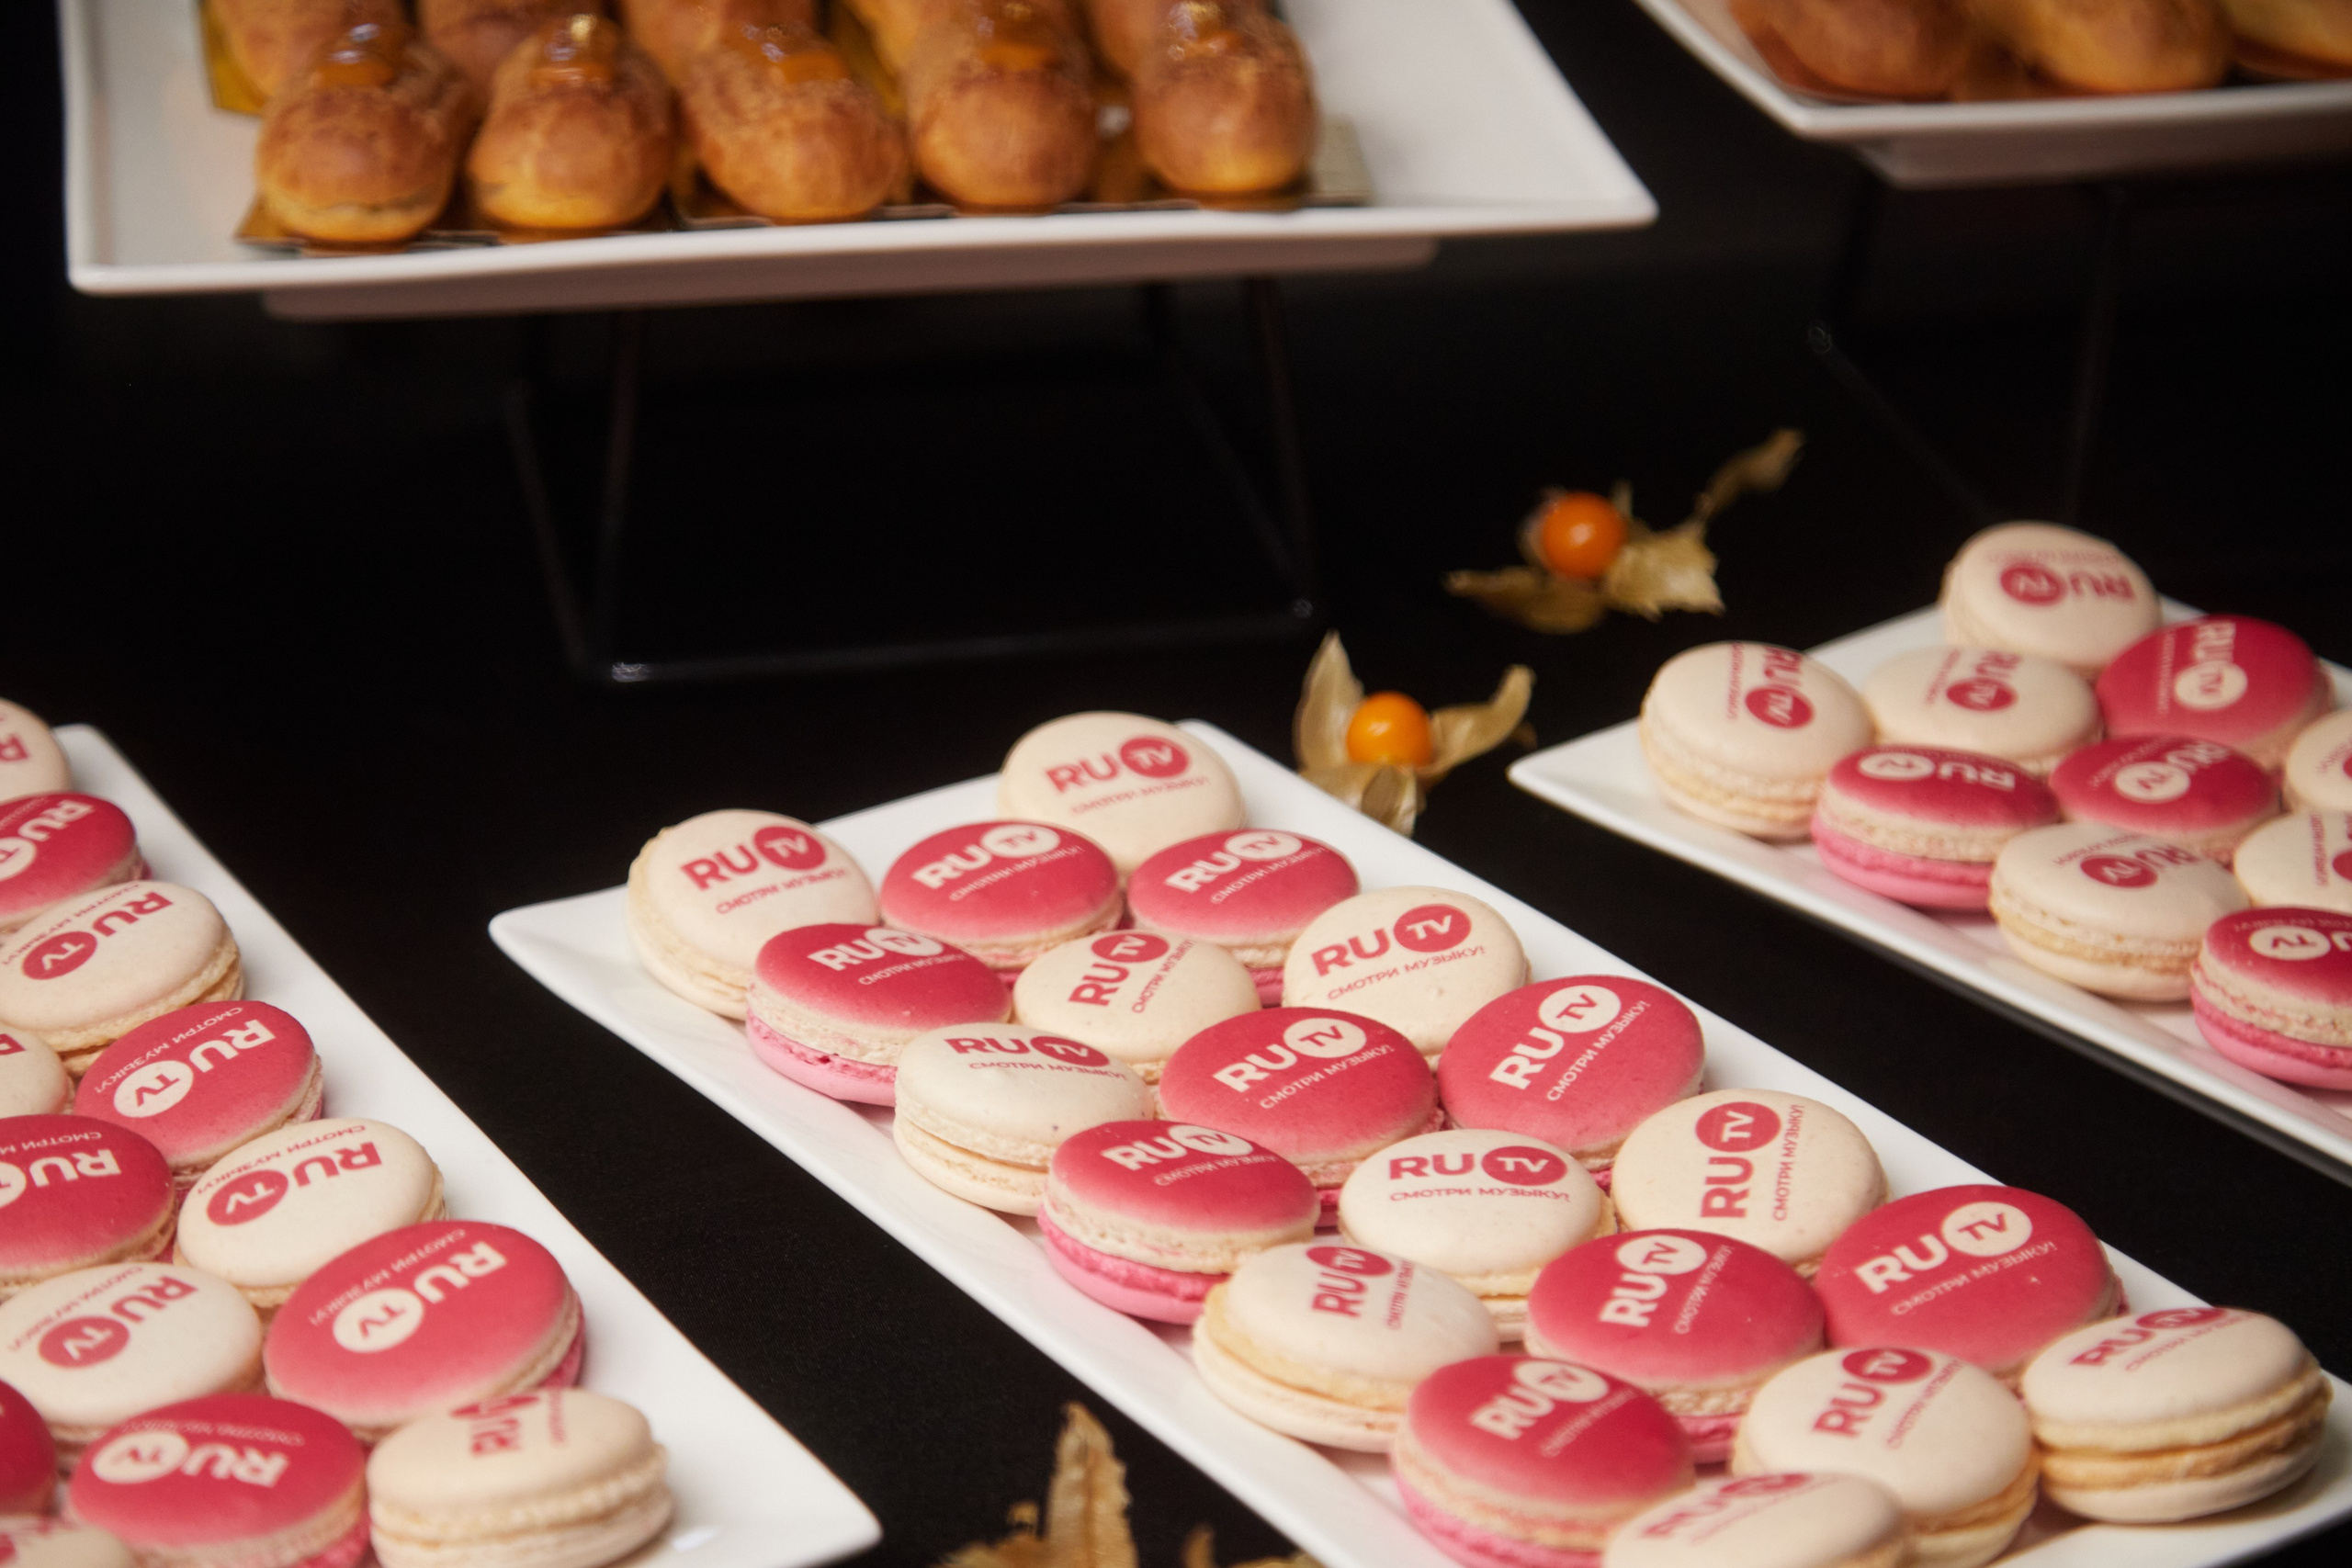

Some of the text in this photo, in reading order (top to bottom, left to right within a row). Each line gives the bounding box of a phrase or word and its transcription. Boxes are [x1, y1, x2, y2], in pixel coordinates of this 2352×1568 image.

[1045, 745, 1176, 793] RU TV
[17, 800, 94, 841] RU
[680, 835, 810, 891] RU TV
[912, 829, 1038, 889] RU TV
[1165, 834, 1284, 893] RU TV
[41, 892, 174, 971] RU TV
[808, 931, 921, 972] RU TV
[1311, 915, 1453, 977] RU TV
[1069, 935, 1147, 1007] RU TV
[1327, 945, 1487, 1001] СМОТРИ МУЗЫКУ!
[94, 1007, 243, 1094] СМОТРИ МУЗЫКУ!
[135, 1020, 276, 1108] RU TV
[944, 1037, 1089, 1059] RU TV
[969, 1061, 1045, 1072] СМОТРИ
[1213, 1024, 1340, 1093] RU TV
[1489, 992, 1600, 1090] RU TV
[1546, 999, 1651, 1102] СМОТРИ МУЗЫКУ!
[1260, 1043, 1395, 1110] СМОТРИ МУЗЫКУ!
[21, 1132, 102, 1150] СМОТРИ
[28, 1149, 121, 1187] RU
[197, 1124, 366, 1194] СМОТРИ МУЗЫКУ!
[1101, 1132, 1230, 1171] RU TV
[1389, 1154, 1550, 1180] RU TV
[1700, 1111, 1755, 1218] RU TV
[1773, 1104, 1804, 1222] СМОТРИ МУЗЫКУ!
[225, 1142, 382, 1214] RU TV
[1153, 1161, 1218, 1187] СМОТРИ
[1390, 1188, 1571, 1203] СМОТРИ МУЗЫКУ!
[1856, 1213, 2009, 1294] RU TV
[1891, 1239, 2059, 1317] СМОТРИ МУЗЫКУ!
[356, 1241, 507, 1338] RU TV
[1312, 1273, 1369, 1318] RU
[1598, 1241, 1679, 1328] RU TV
[62, 1276, 198, 1359] RU TV
[2069, 1327, 2157, 1368] RU
[1472, 1387, 1555, 1440] RU
[1812, 1350, 1910, 1438] RU TV
[181, 1443, 288, 1487] RU
